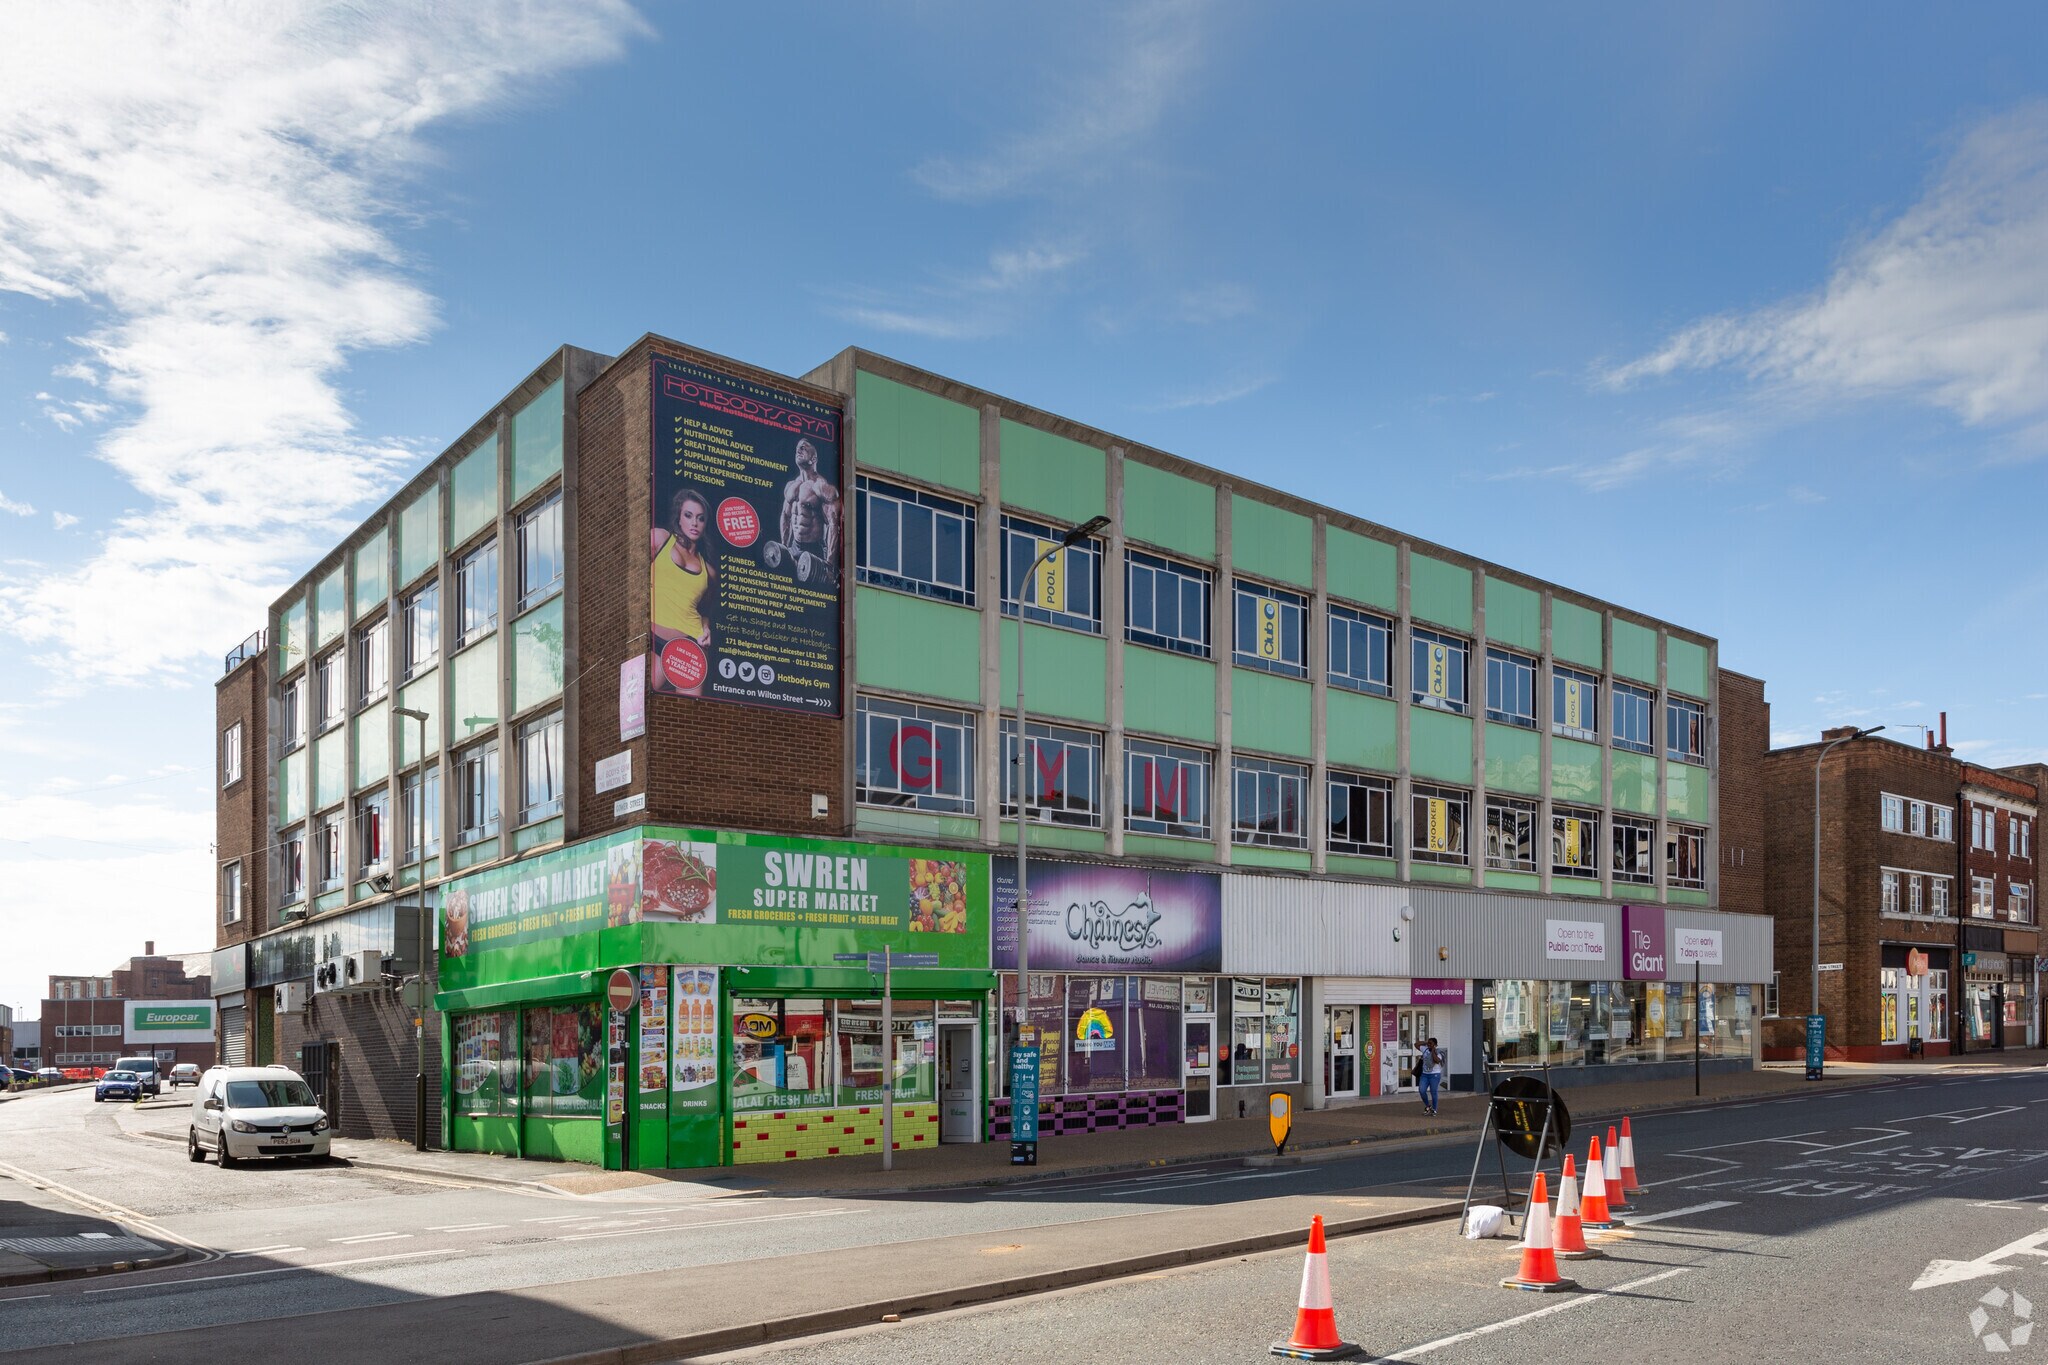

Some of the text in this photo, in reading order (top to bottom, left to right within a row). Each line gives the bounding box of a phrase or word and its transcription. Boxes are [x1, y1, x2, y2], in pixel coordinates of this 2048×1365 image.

[668, 362, 721, 383] LEICESTER'S
[749, 386, 770, 397] BODY
[774, 393, 811, 409] BUILDING
[814, 406, 830, 415] GYM
[667, 377, 830, 436] HOTBODYS GYM
[699, 400, 801, 434] www.hotbodysgym.com
[683, 417, 734, 438] HELP & ADVICE
[683, 428, 754, 454] NUTRITIONAL ADVICE
[683, 439, 789, 472] GREAT TRAINING ENVIRONMENT
[683, 449, 746, 472] SUPPLIMENT SHOP
[683, 460, 774, 489] HIGHLY EXPERIENCED STAFF
[683, 470, 726, 488] PT SESSIONS
[723, 515, 755, 531] FREE
[728, 555, 756, 568] SUNBEDS
[728, 565, 793, 584] REACH GOALS QUICKER
[728, 574, 838, 602] NO NONSENSE TRAINING PROGRAMMES
[728, 583, 827, 609] PRE/POST WORKOUT SUPPLIMENTS
[1046, 569, 1056, 604] POOL
[728, 592, 805, 613] COMPETITION PREP ADVICE
[728, 602, 786, 619] NUTRITIONAL PLANS
[715, 622, 740, 634] Perfect
[741, 627, 760, 640] Body
[762, 631, 789, 642] Quicker
[750, 617, 771, 628] Shape
[772, 621, 786, 630] and
[787, 624, 808, 634] Reach
[809, 628, 826, 638] Your
[725, 637, 737, 645] 171
[737, 639, 763, 650] Belgrave
[763, 644, 779, 653] Gate,
[780, 646, 805, 657] Leicester
[806, 651, 816, 659] LE1
[1263, 621, 1274, 656] Club
[718, 646, 791, 664] mail@hotbodysgym.com
[795, 659, 810, 668] 0116
[777, 673, 830, 690] Hotbodys Gym
[1433, 663, 1443, 694] Club
[713, 683, 804, 704] Entrance on Wilton Street
[764, 851, 868, 892] SWREN
[469, 859, 607, 925] SWREN SUPER MARKET
[753, 888, 879, 913] SUPER MARKET
[471, 902, 603, 942] FRESH GROCERIES FRESH FRUIT FRESH MEAT
[727, 908, 899, 926] FRESH GROCERIES FRESH FRUIT FRESH MEAT
[1557, 927, 1594, 940] Open to the
[1631, 930, 1651, 951] Tile
[1684, 935, 1714, 948] Open early
[1548, 941, 1603, 954] Public and Trade
[1684, 948, 1699, 959] days
[1704, 949, 1718, 958] week
[1632, 952, 1664, 973] Giant
[1414, 987, 1463, 996] Showroom entrance
[146, 1012, 199, 1024] Europcar
[639, 1102, 667, 1110] SNACKS
[682, 1100, 708, 1108] DRINKS
[766, 1092, 832, 1107] FRESH MEAT
[612, 1132, 621, 1140] TEA
